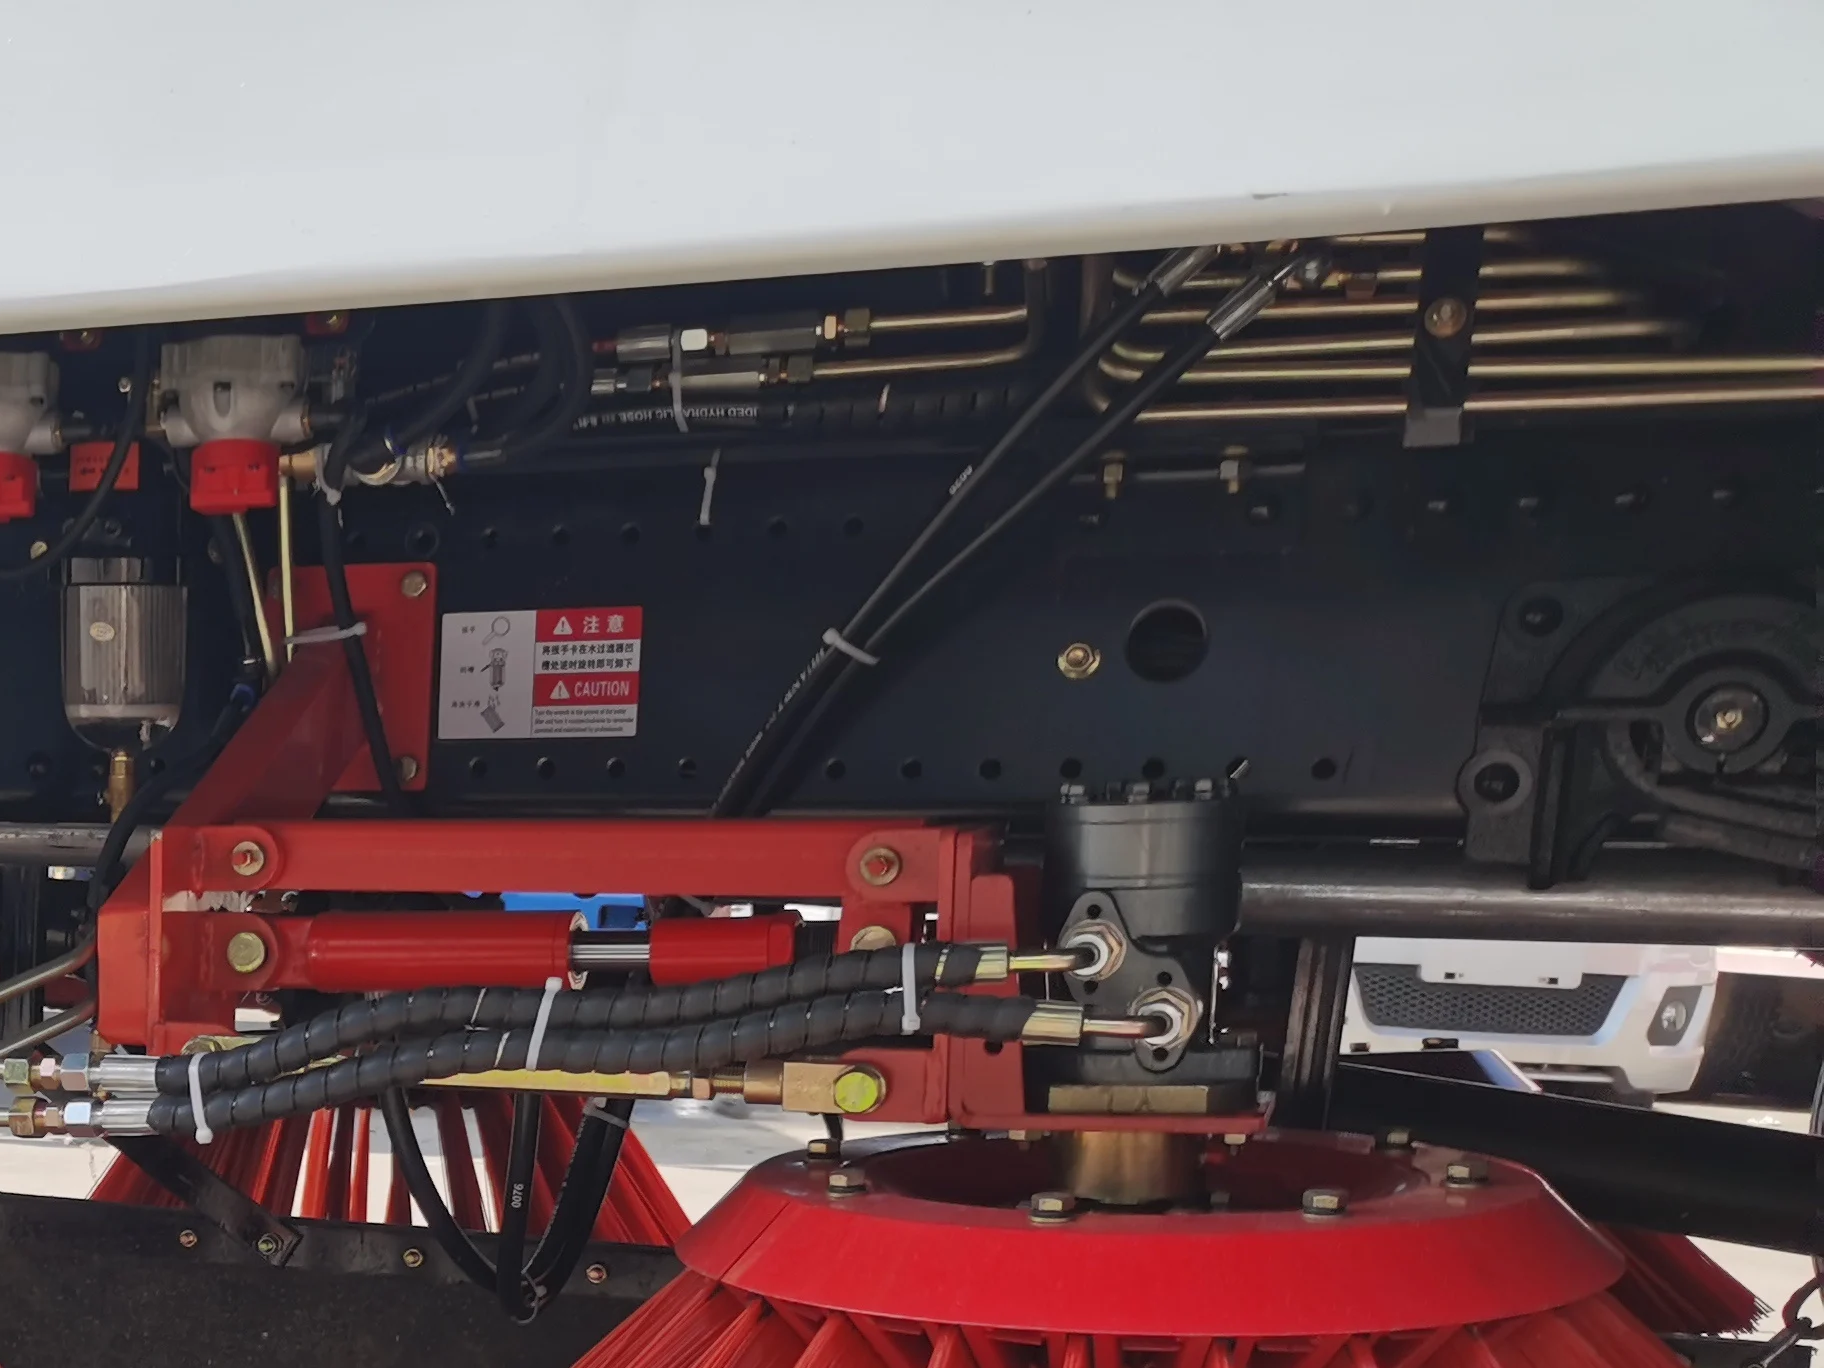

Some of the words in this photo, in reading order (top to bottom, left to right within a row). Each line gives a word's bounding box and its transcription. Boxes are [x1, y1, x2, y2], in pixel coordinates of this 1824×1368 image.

[655, 406, 726, 421] HYDRALIC
[582, 614, 625, 634] 注意
[574, 680, 630, 698] CAUTION
[511, 1183, 525, 1208] 0076
